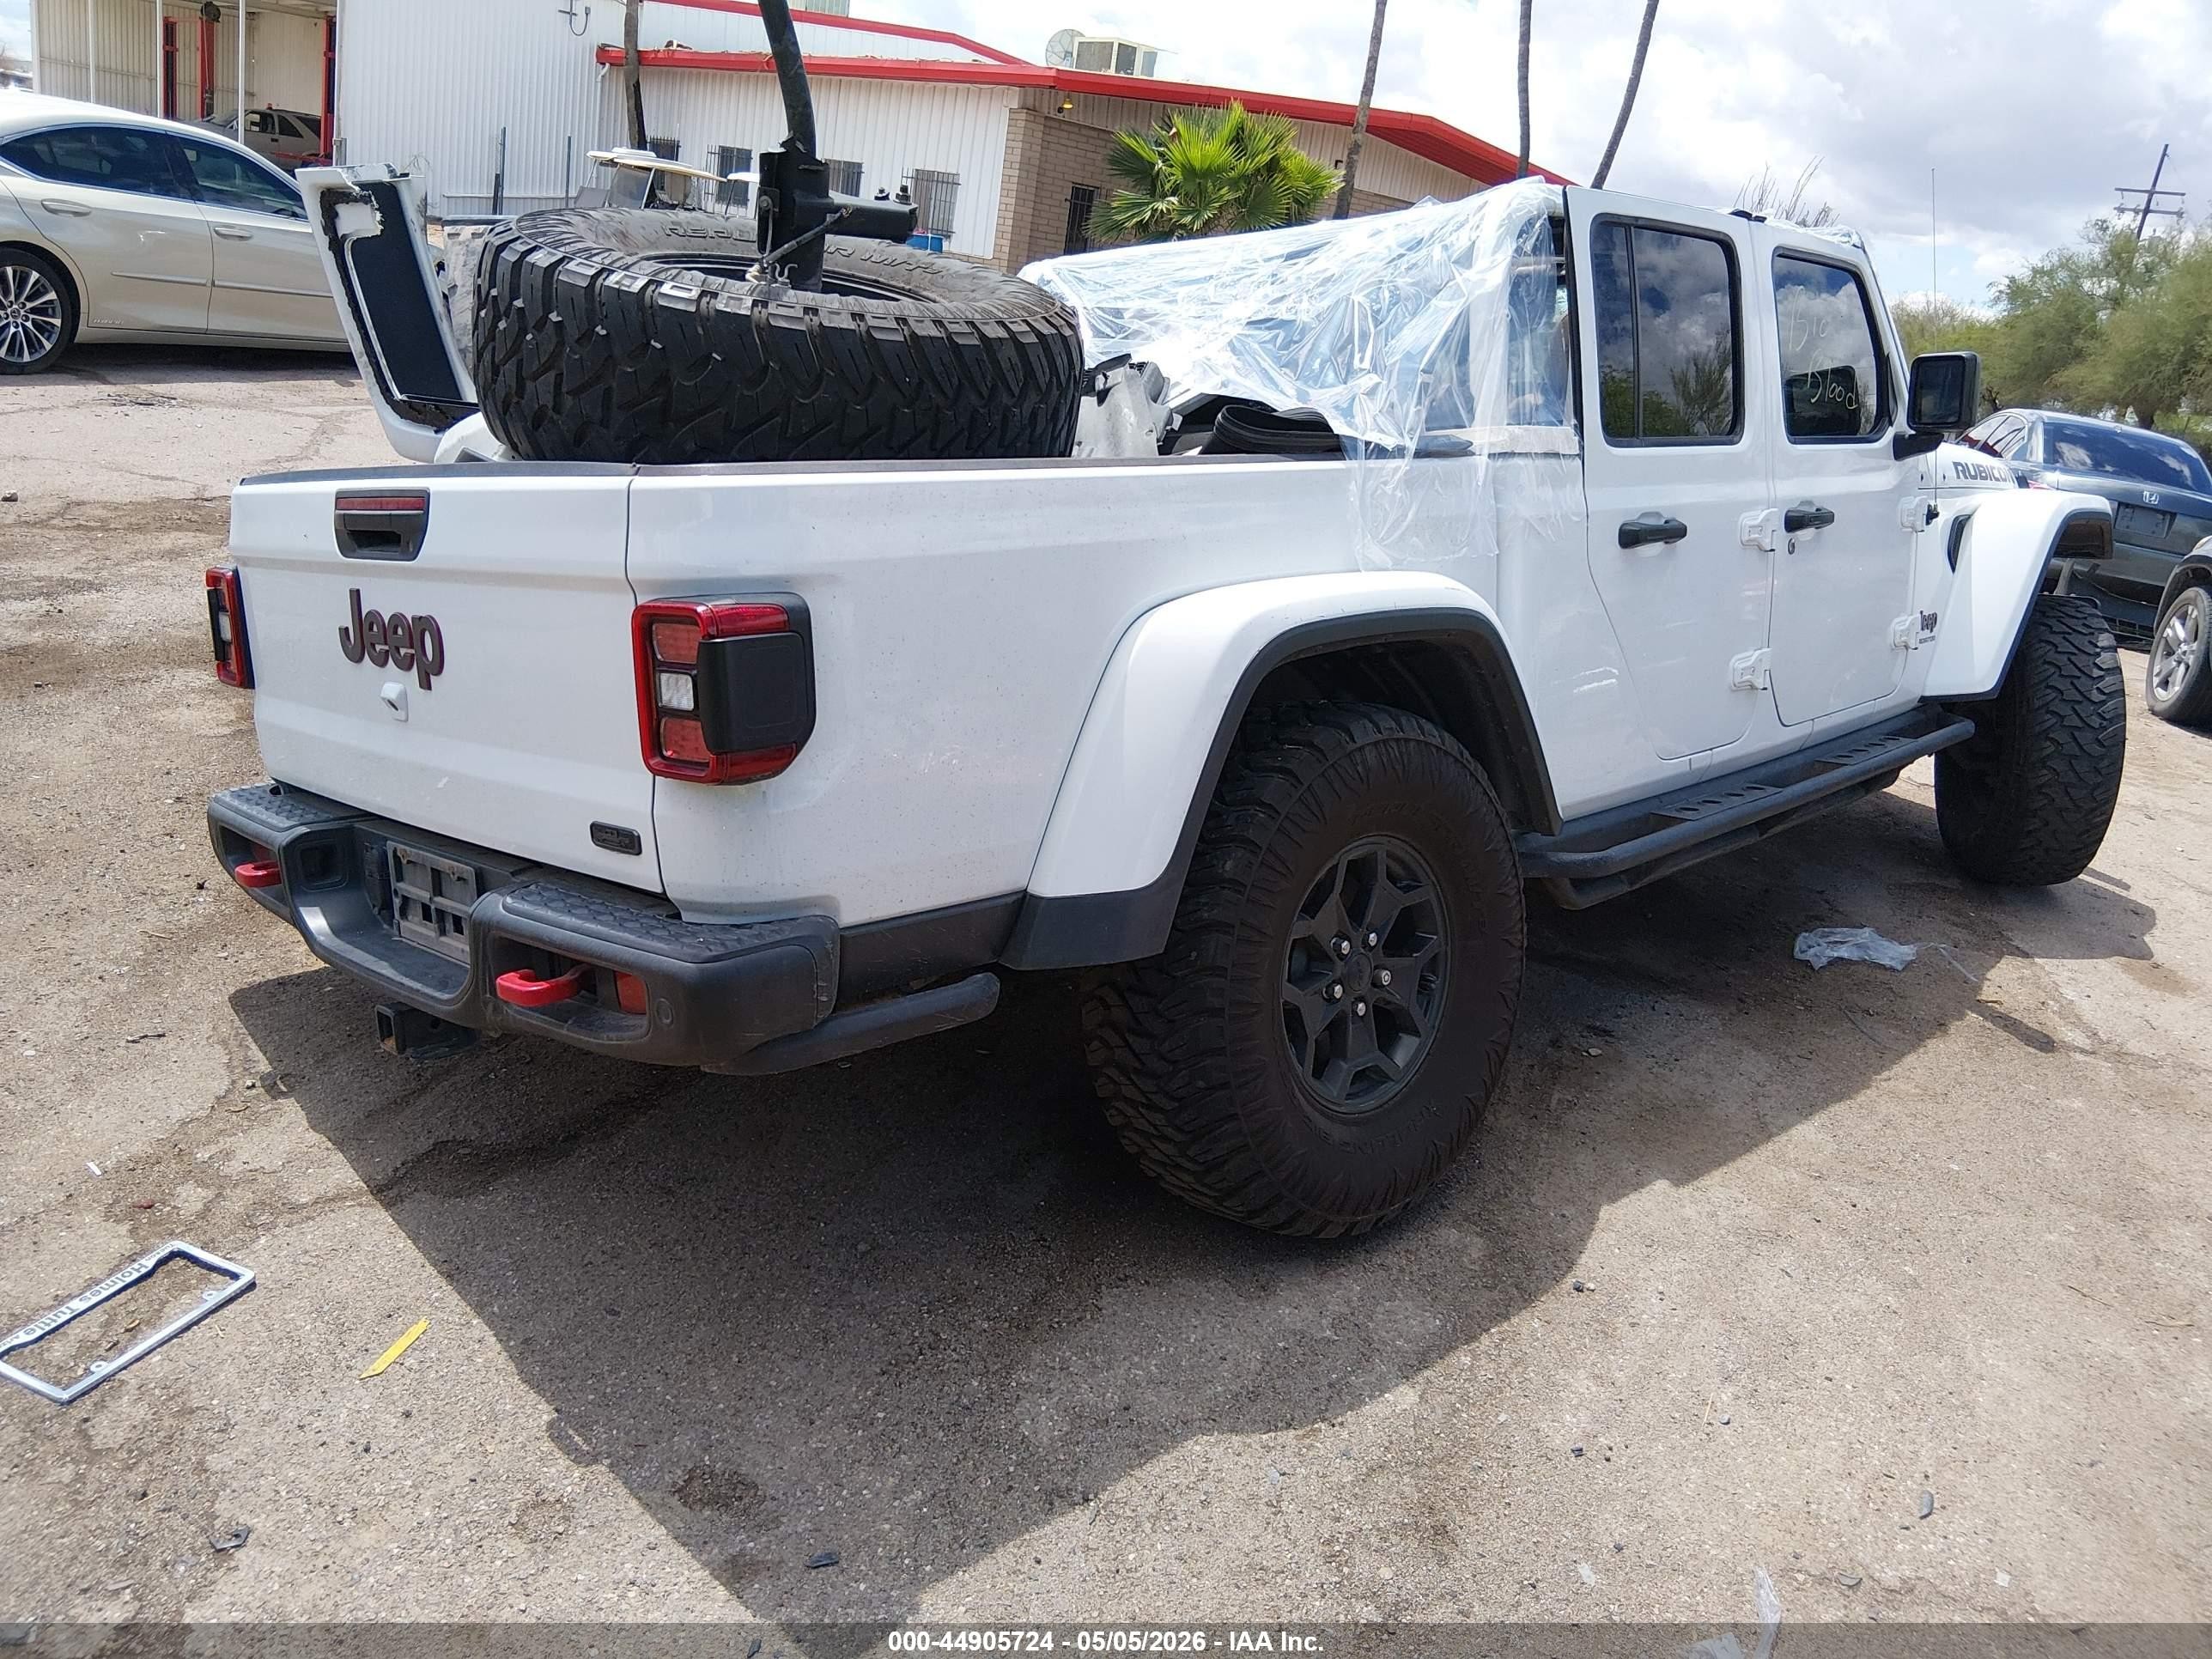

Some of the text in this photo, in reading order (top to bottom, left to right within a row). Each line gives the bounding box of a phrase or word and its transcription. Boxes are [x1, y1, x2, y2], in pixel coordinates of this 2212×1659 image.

[1807, 348, 1858, 410] Blood
[337, 587, 445, 691] Jeep
[79, 1261, 149, 1303] Holmes
[23, 1305, 80, 1336] Tuttle
